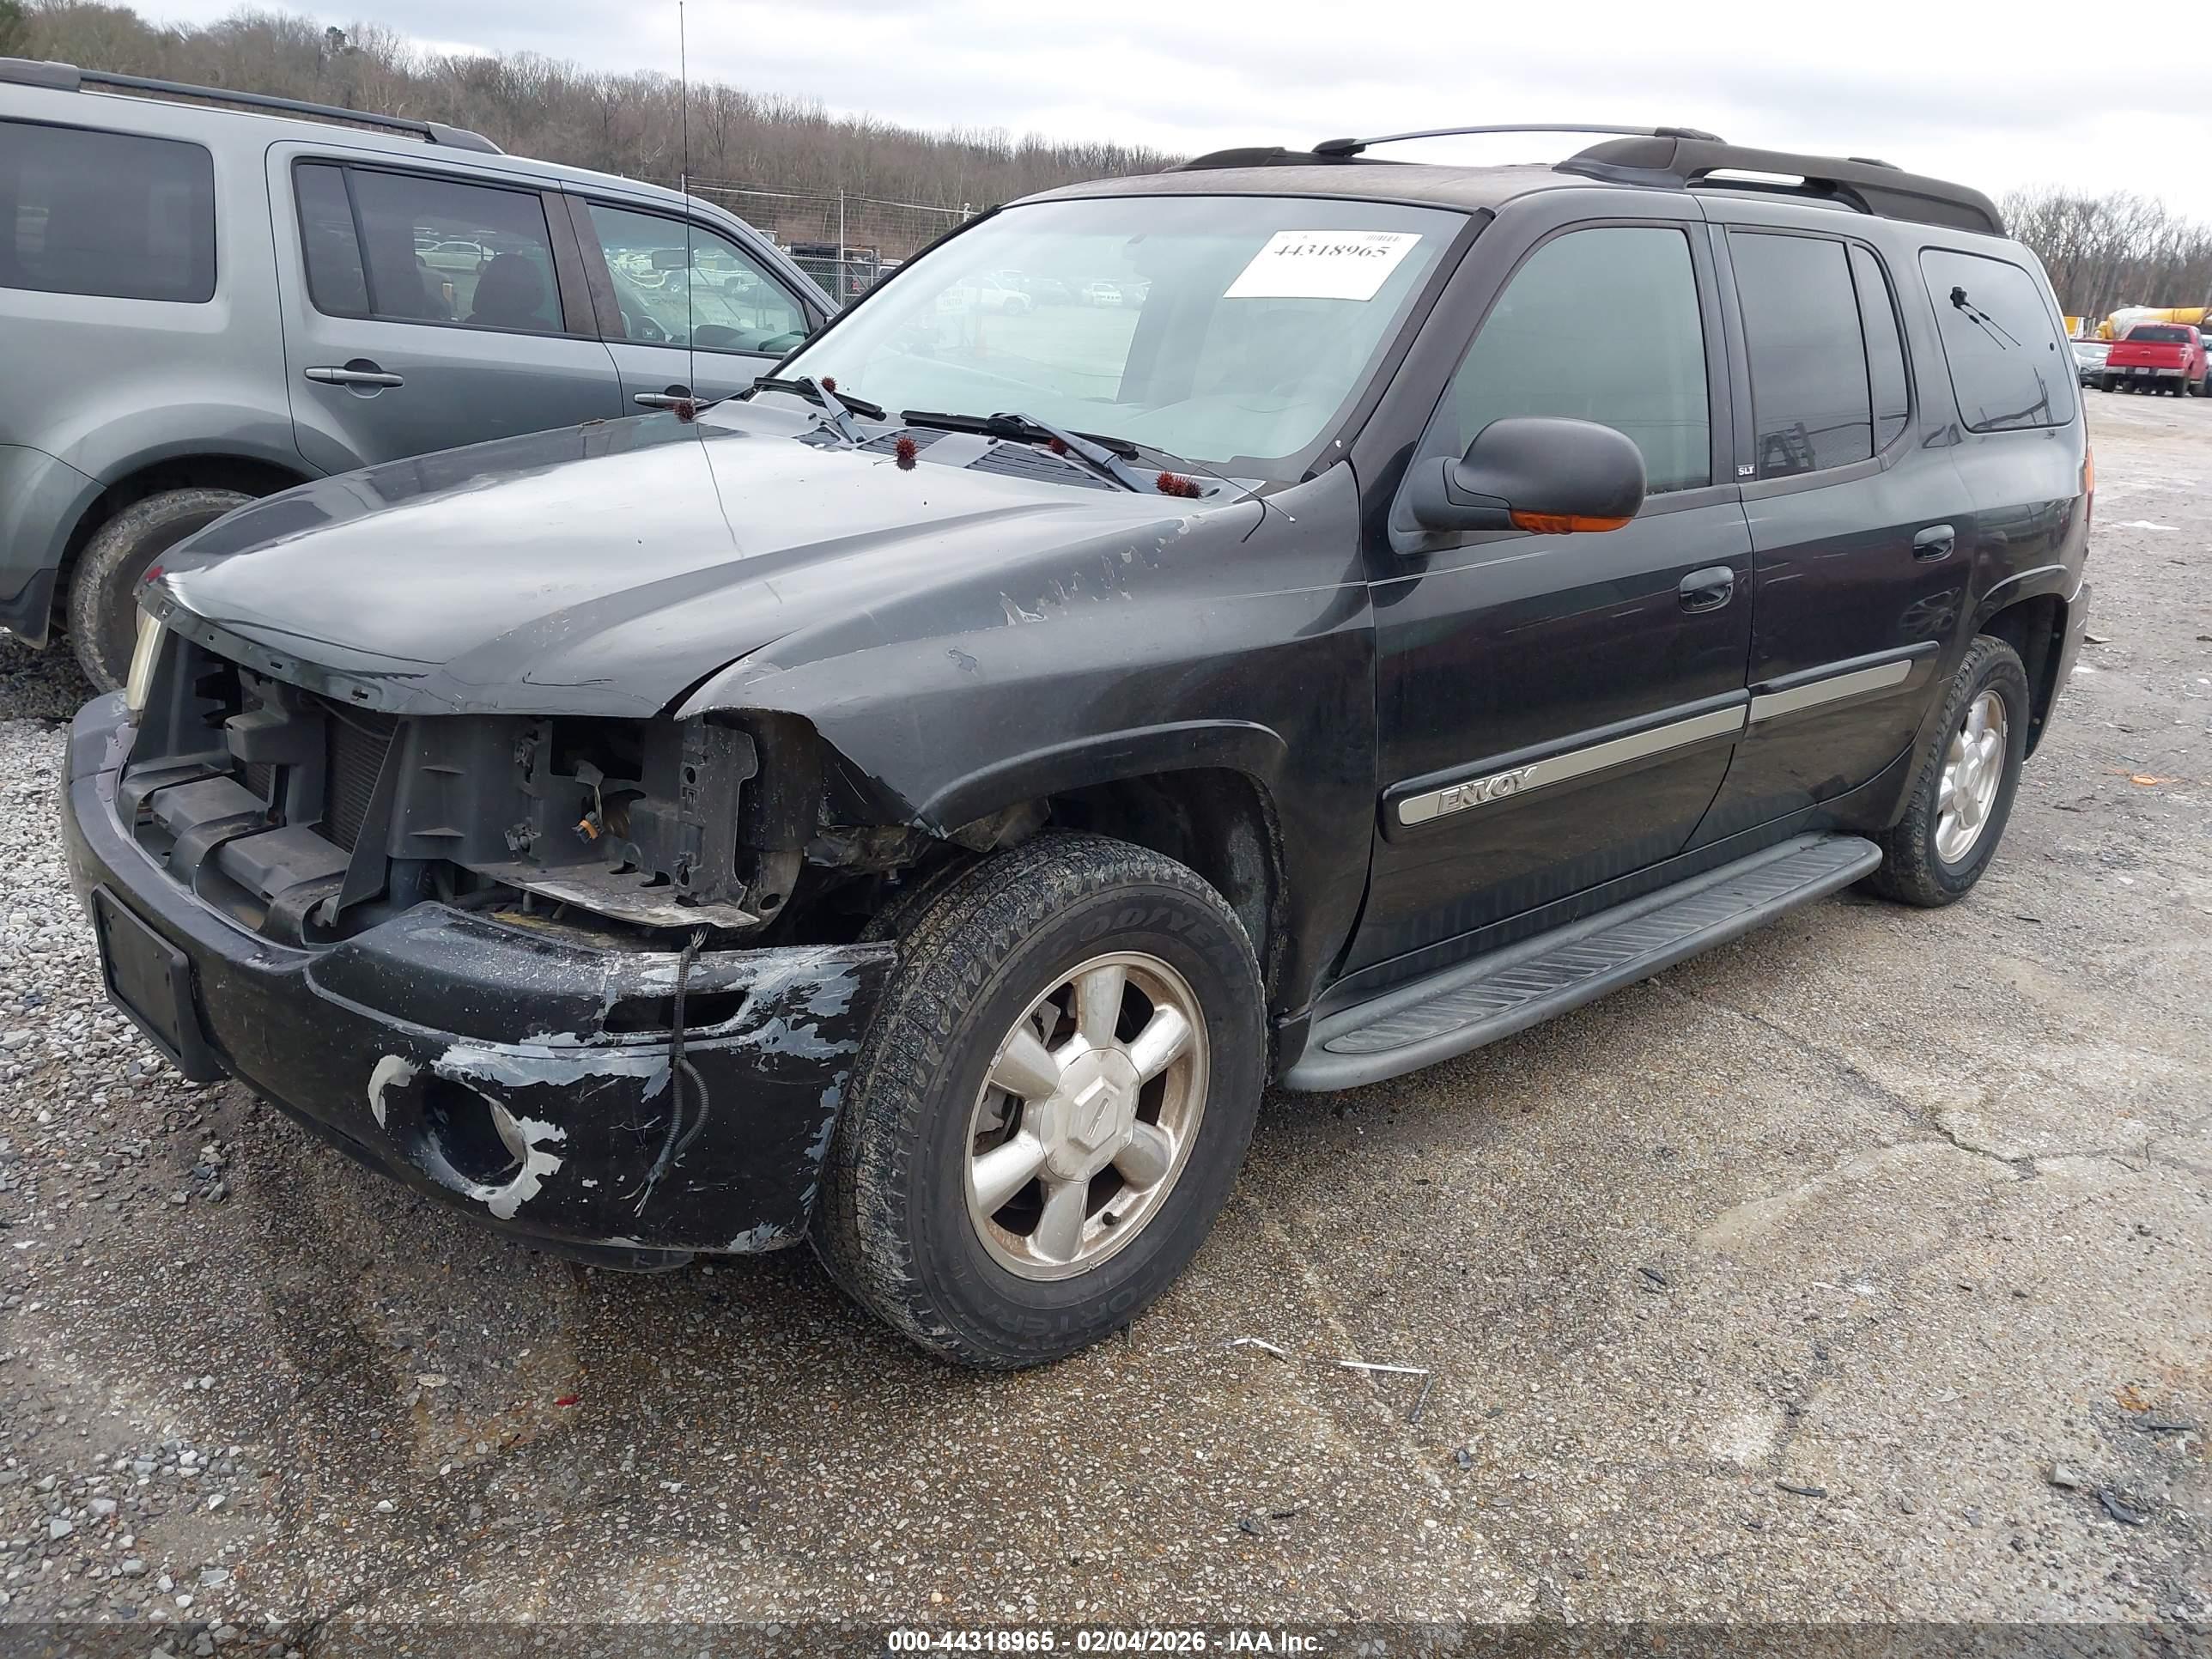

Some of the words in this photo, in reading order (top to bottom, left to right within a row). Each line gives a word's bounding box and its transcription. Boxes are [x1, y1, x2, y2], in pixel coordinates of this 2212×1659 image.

[1274, 245, 1391, 258] 44318965
[1738, 466, 1754, 476] SLT
[1438, 766, 1538, 814] ENVOY
